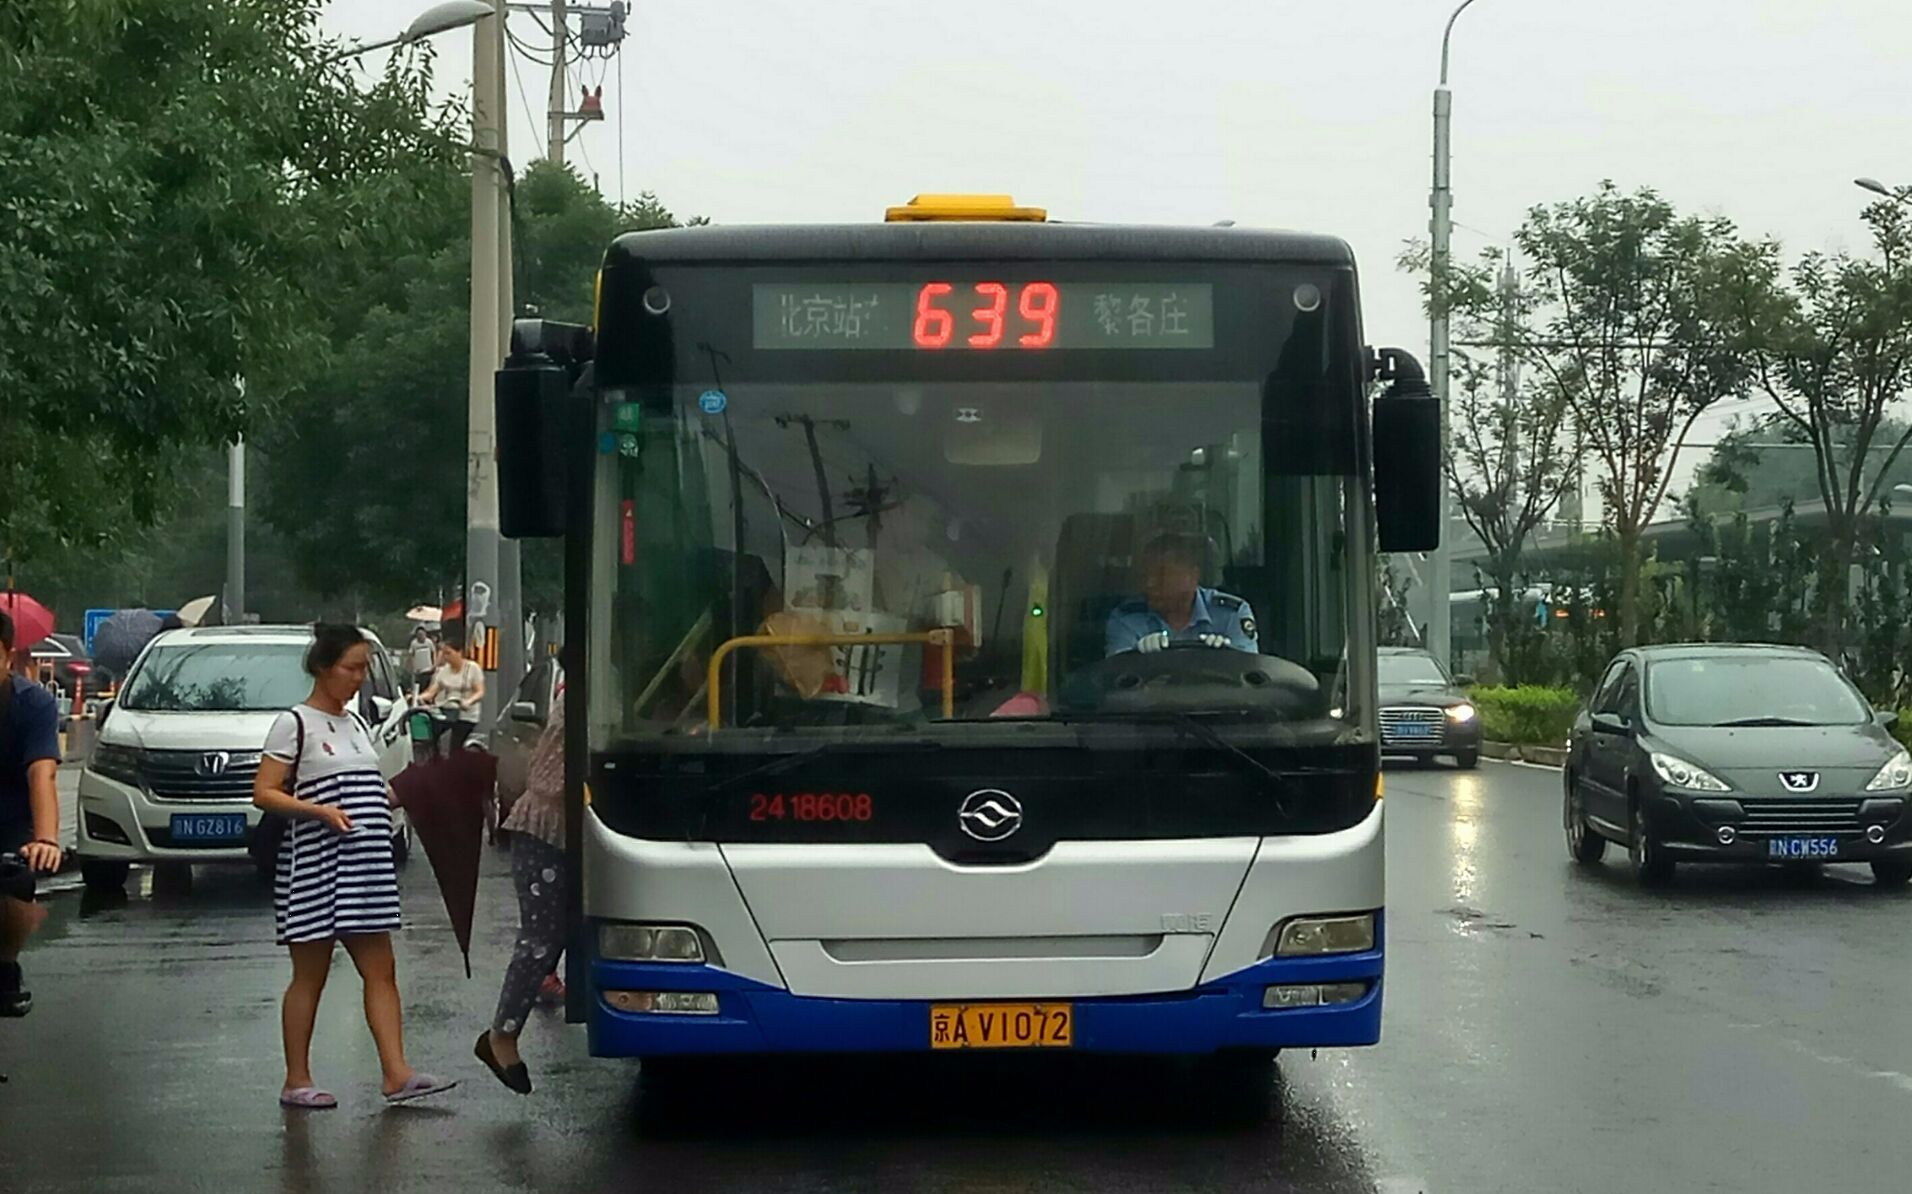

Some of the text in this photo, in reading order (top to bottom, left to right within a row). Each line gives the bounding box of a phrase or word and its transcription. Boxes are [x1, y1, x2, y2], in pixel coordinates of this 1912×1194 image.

[912, 281, 1061, 350] 639
[1094, 292, 1189, 336] 黎各庄
